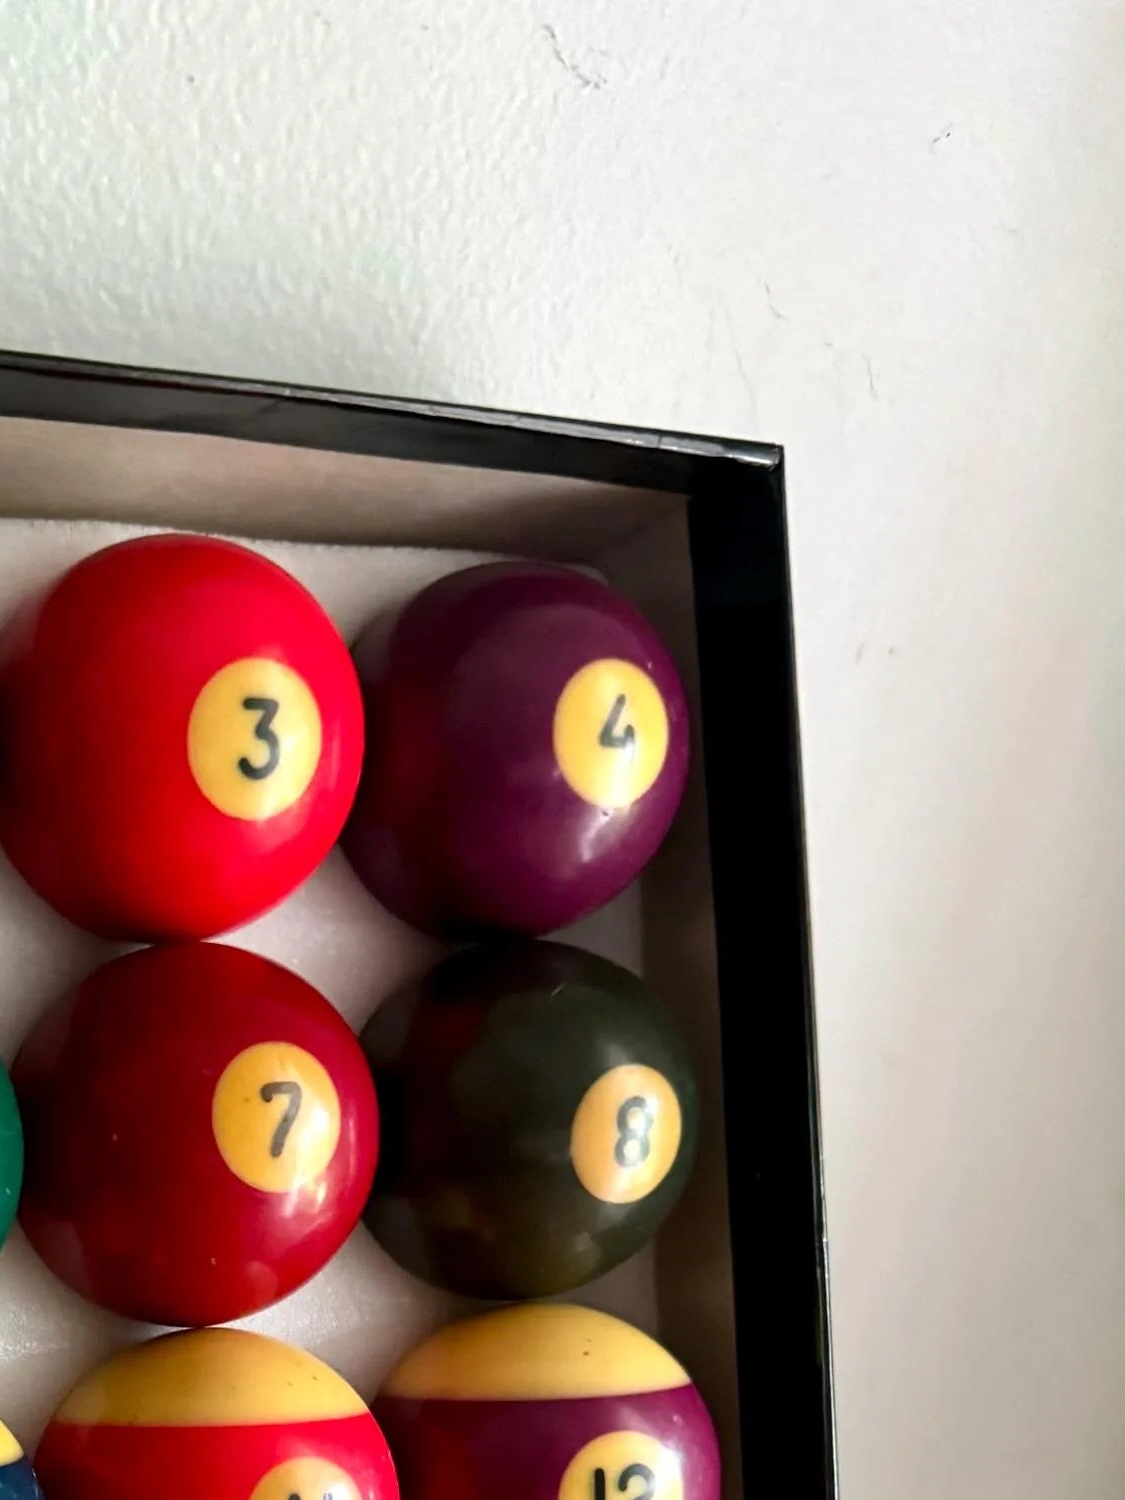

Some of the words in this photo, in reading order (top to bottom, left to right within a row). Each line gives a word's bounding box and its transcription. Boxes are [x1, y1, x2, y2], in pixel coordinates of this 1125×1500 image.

[239, 696, 280, 781] 3
[599, 692, 637, 767] 4
[259, 1081, 303, 1158] 7
[614, 1095, 655, 1168] 8
